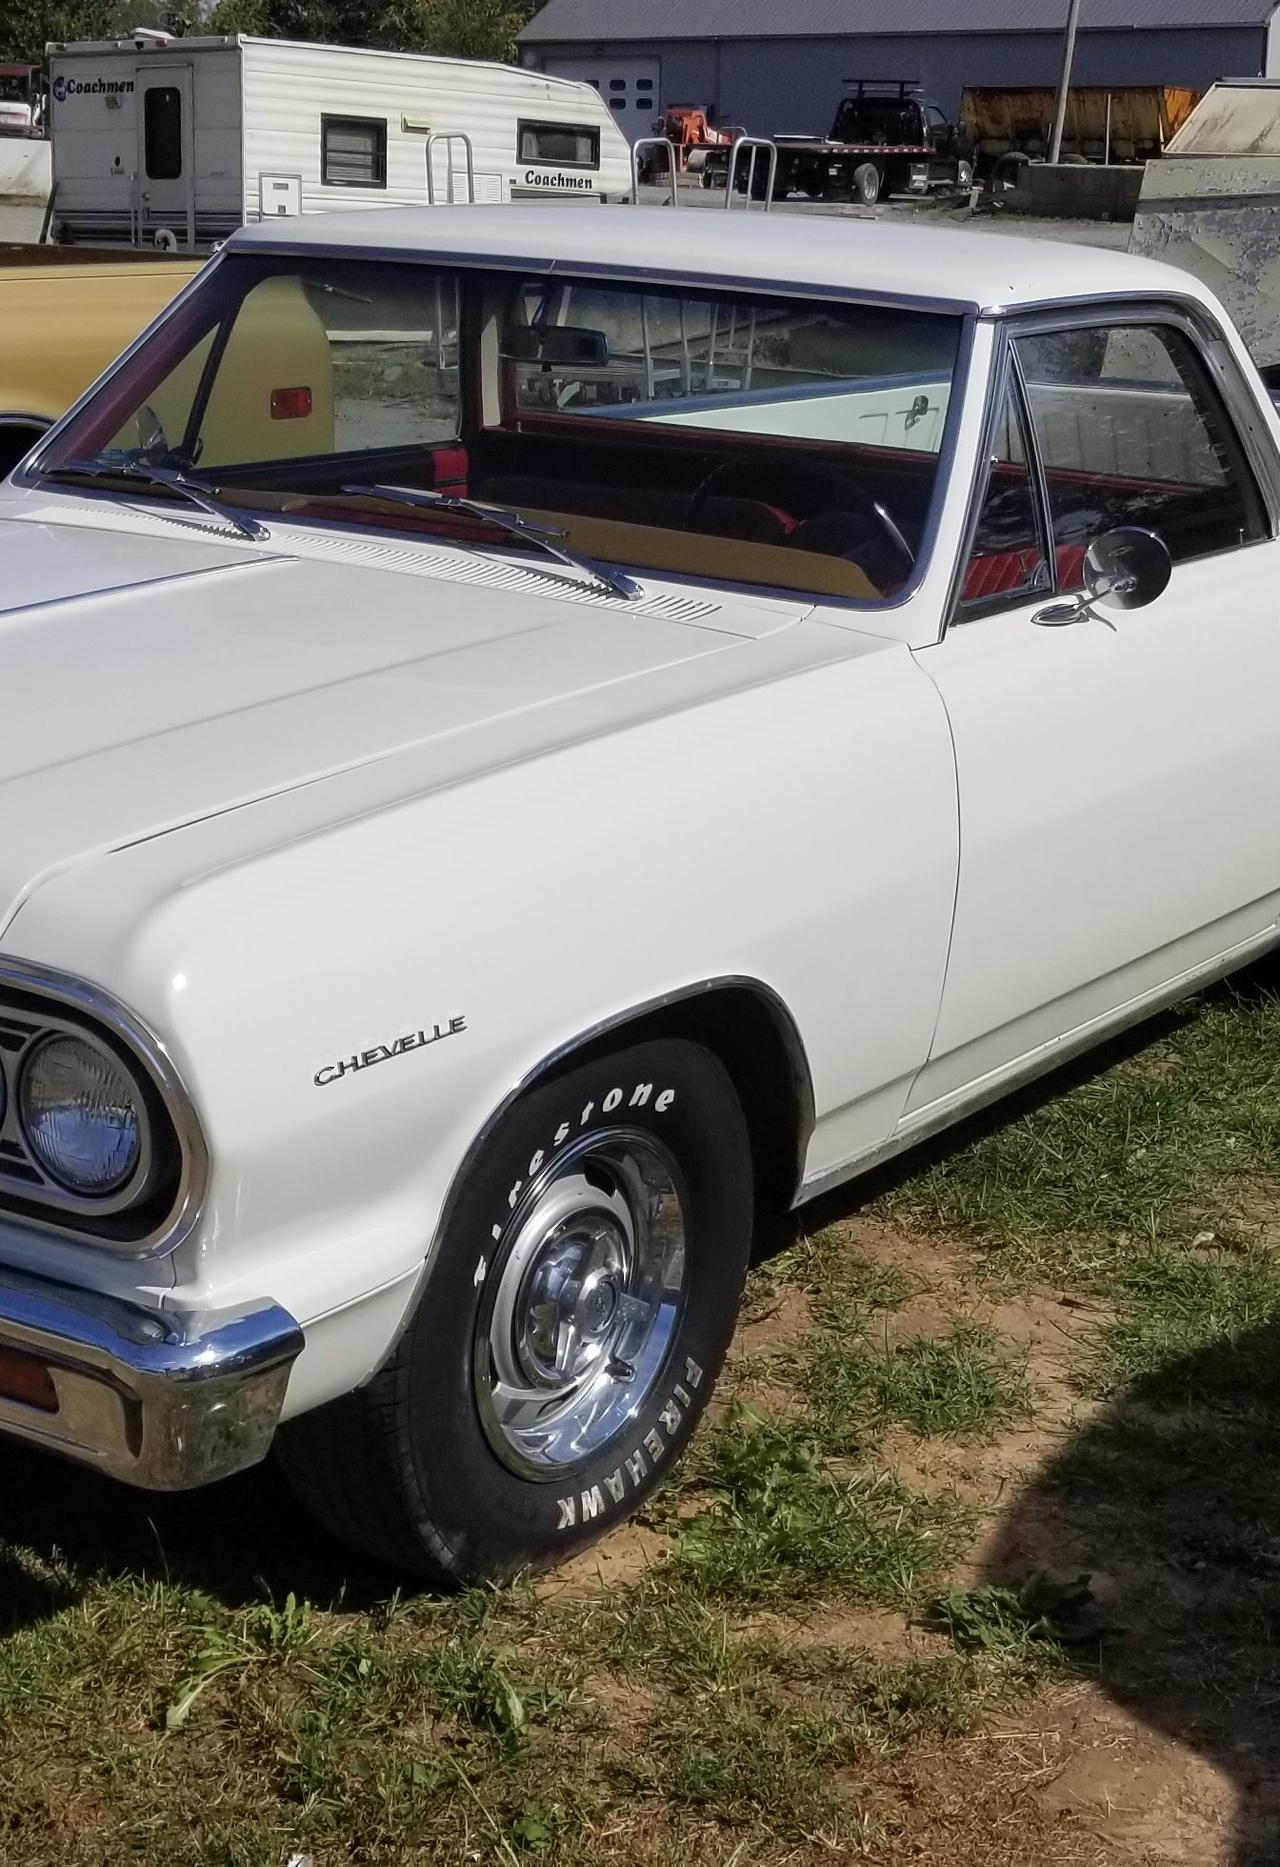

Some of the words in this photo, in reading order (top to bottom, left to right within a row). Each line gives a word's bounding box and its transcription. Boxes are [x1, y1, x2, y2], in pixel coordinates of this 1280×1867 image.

[67, 78, 134, 94] Coachmen
[524, 170, 593, 189] Coachmen
[313, 1015, 468, 1087] CHEVELLE
[473, 1083, 675, 1288] Firestone
[557, 1356, 704, 1530] FIREHAWK
